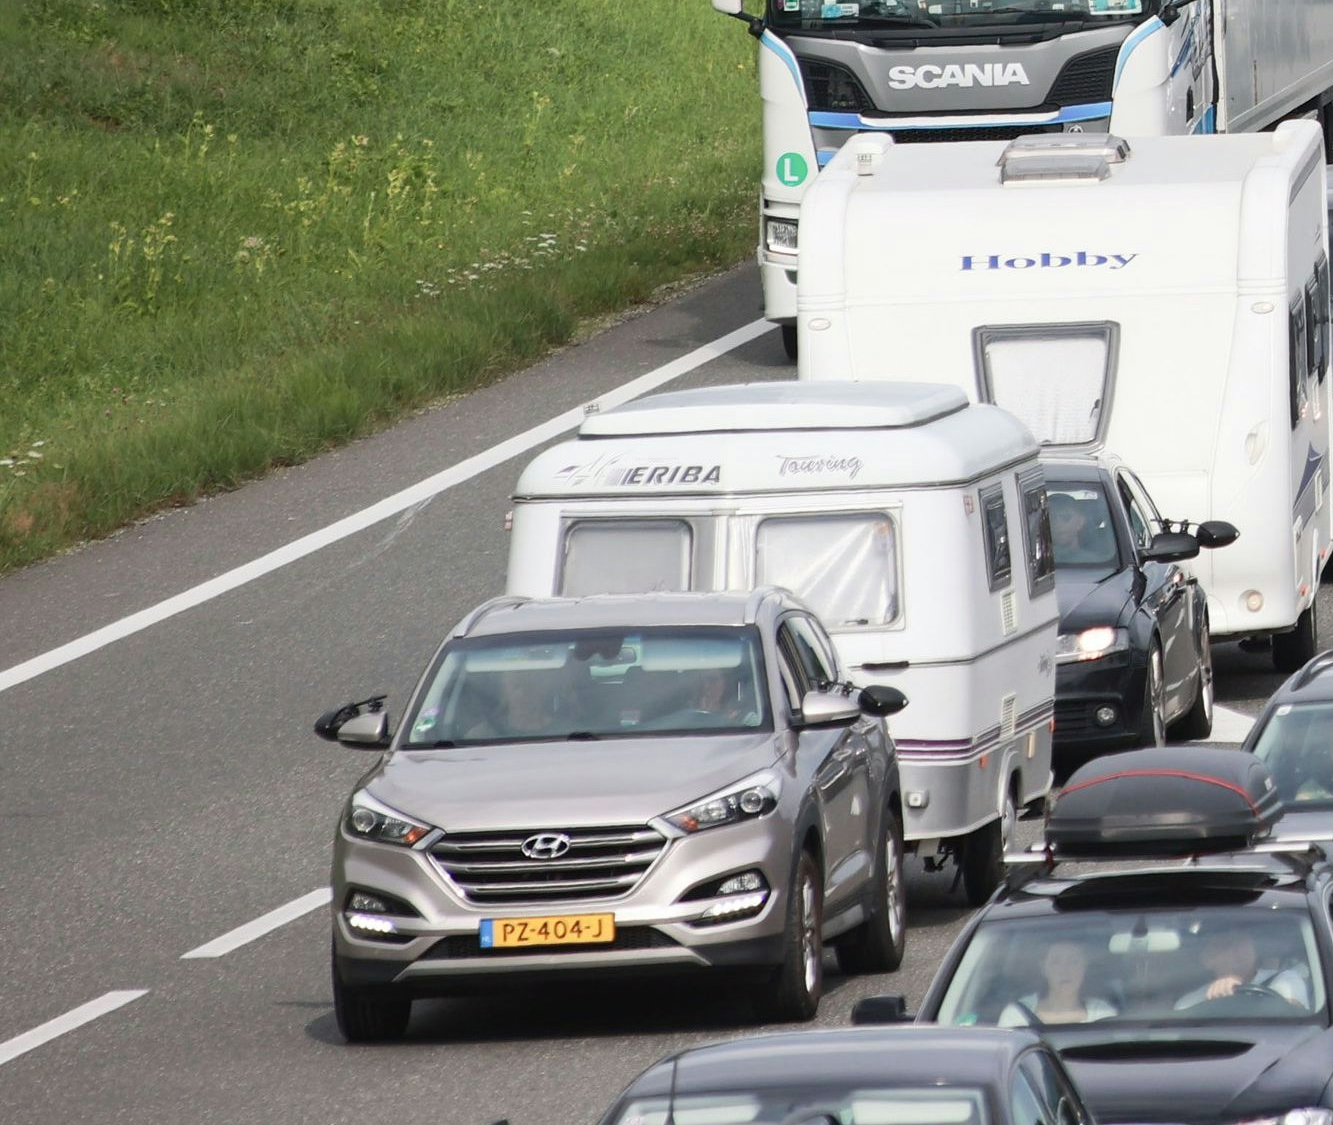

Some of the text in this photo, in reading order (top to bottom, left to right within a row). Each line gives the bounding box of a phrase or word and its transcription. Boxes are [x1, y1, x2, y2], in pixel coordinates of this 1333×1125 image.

[888, 63, 1030, 89] SCANIA
[784, 158, 798, 181] L
[960, 251, 1138, 270] Hobby
[626, 465, 721, 485] ERIBA
[776, 455, 863, 479] Touring
[503, 919, 602, 942] PZ-404-J
